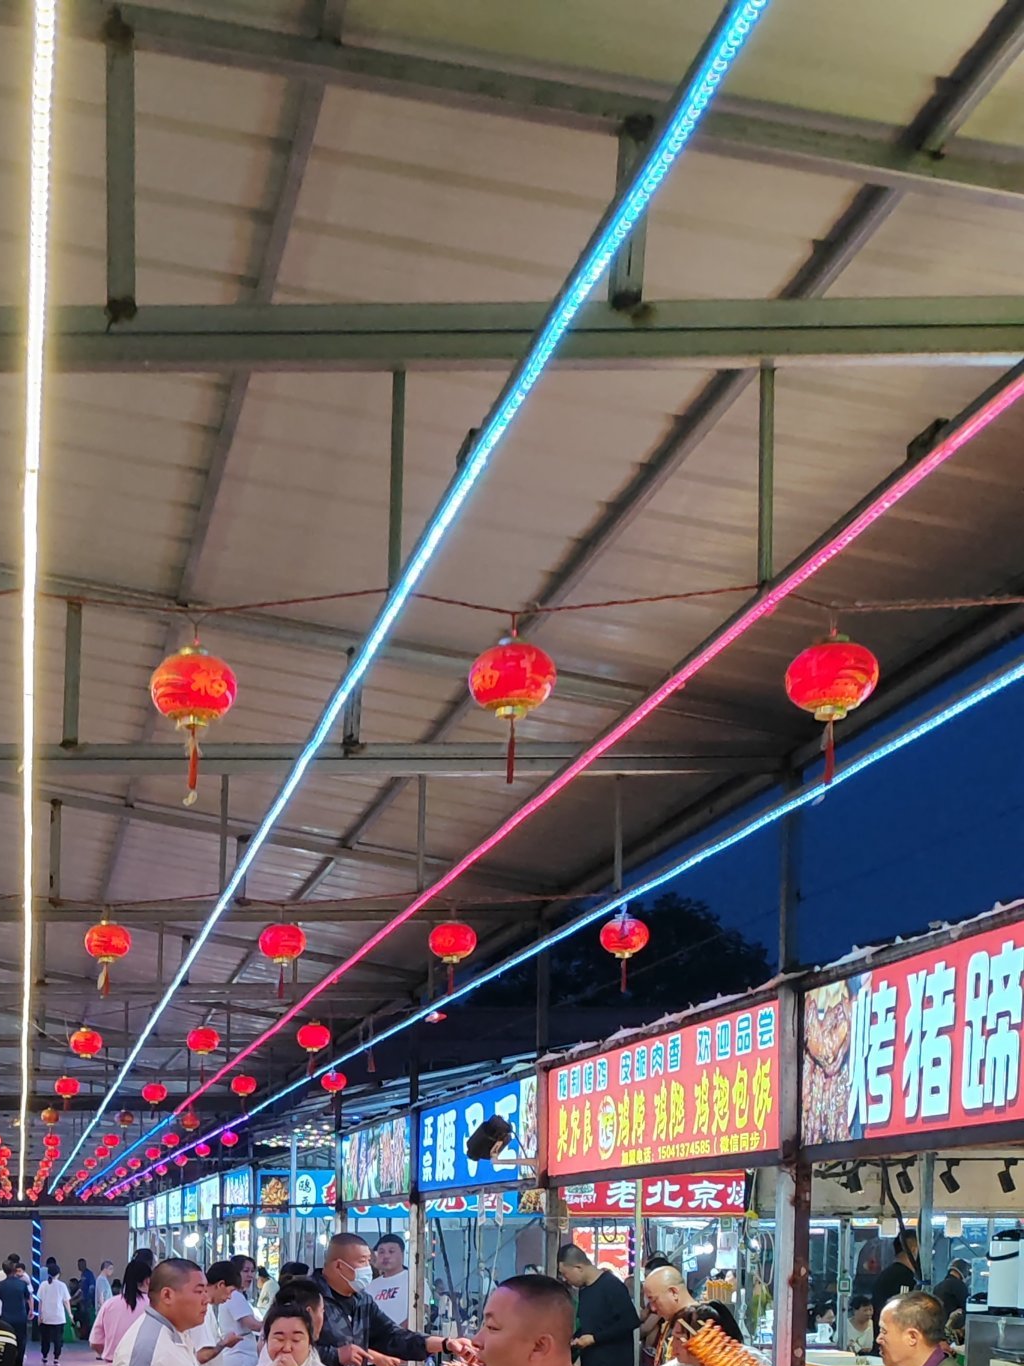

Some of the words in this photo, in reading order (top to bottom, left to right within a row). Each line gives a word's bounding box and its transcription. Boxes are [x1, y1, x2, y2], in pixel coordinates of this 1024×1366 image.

[619, 1034, 682, 1085] 皮脆肉香
[696, 1007, 775, 1066] 欢迎品尝
[847, 940, 1024, 1128] 烤猪蹄
[653, 1079, 685, 1141] 鸡腿
[693, 1057, 773, 1135] 鸡翅包饭
[423, 1115, 433, 1182] 正宗
